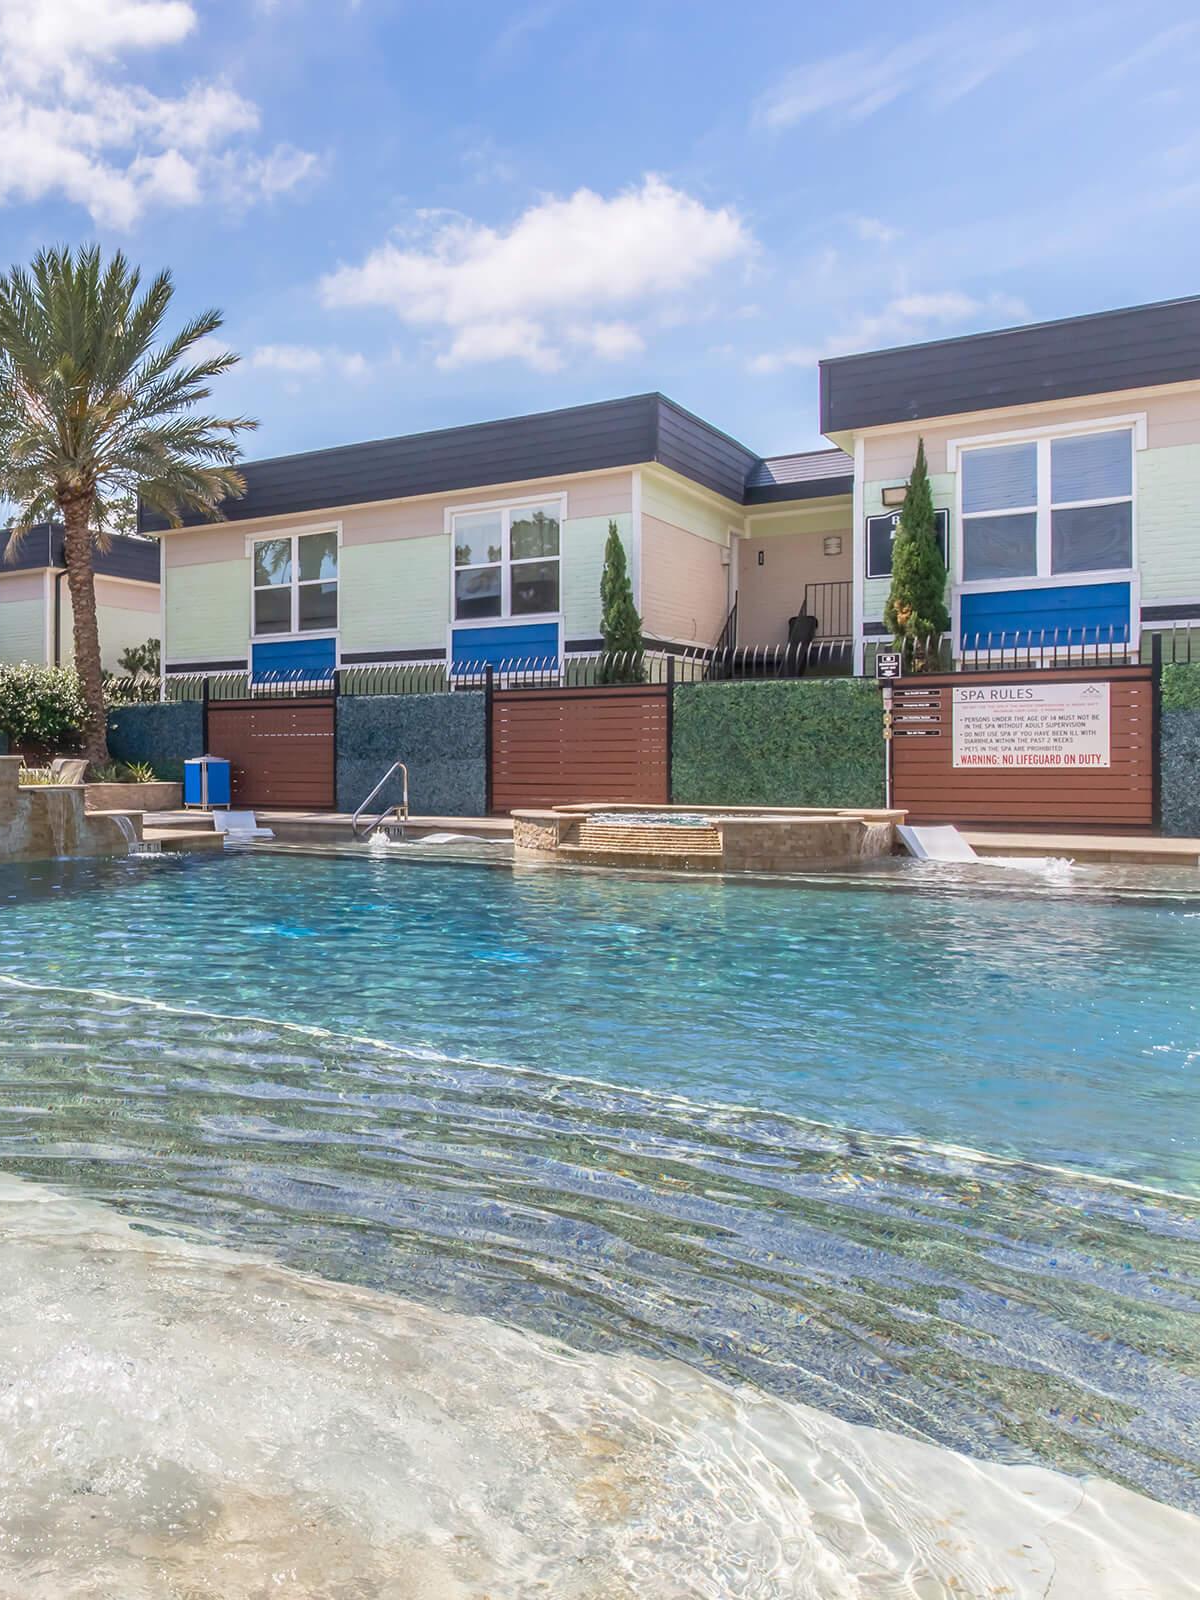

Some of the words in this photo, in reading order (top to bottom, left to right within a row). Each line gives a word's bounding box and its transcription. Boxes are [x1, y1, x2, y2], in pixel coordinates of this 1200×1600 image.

[960, 690, 985, 701] SPA
[990, 688, 1033, 700] RULES
[960, 754, 1000, 765] WARNING:
[1002, 754, 1013, 765] NO
[1016, 754, 1061, 765] LIFEGUARD
[1064, 754, 1076, 764] ON
[1079, 753, 1101, 764] DUTY
